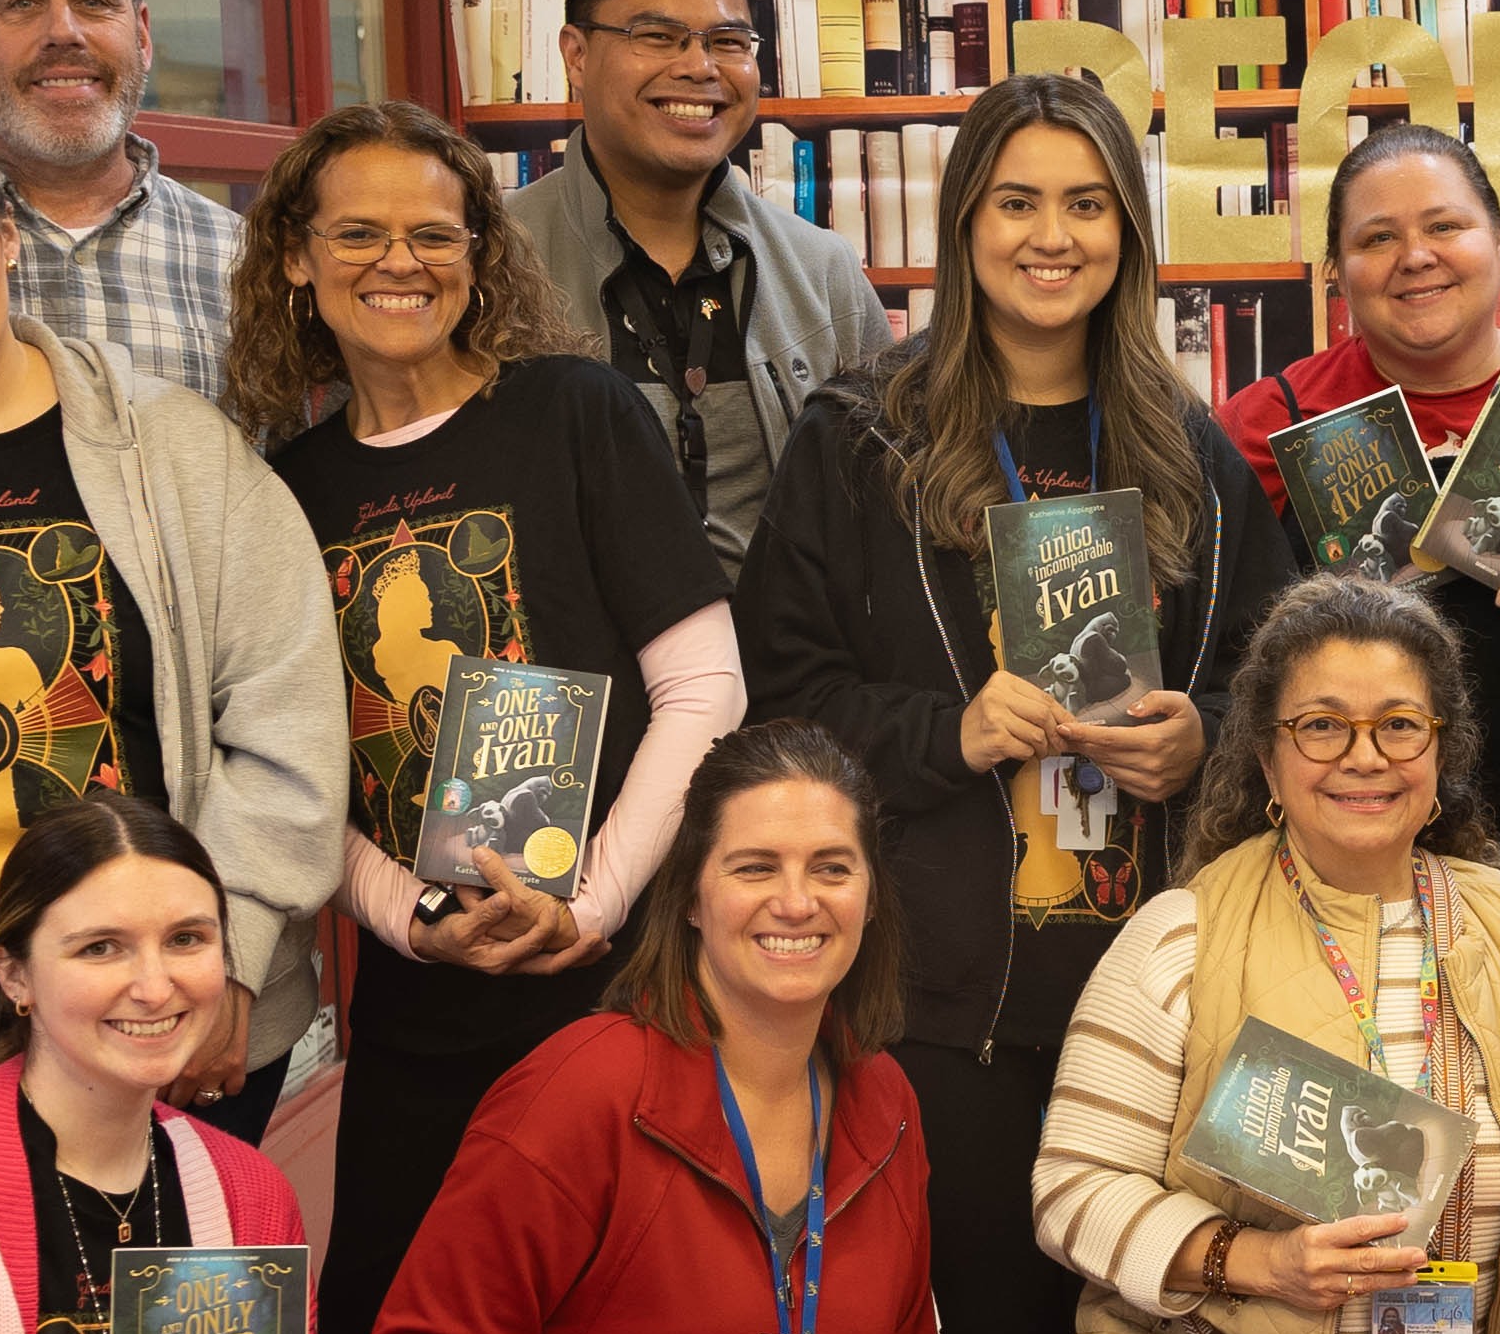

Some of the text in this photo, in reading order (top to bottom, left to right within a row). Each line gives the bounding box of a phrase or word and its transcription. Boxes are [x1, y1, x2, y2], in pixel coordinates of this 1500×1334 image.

[1322, 427, 1360, 467] ONE
[1337, 439, 1381, 485] ONLY
[404, 483, 457, 513] Upland
[1036, 468, 1089, 491] Upland
[1329, 462, 1397, 525] Ivan
[1035, 537, 1113, 582] incomparable
[1038, 524, 1092, 563] único
[1035, 567, 1121, 632] Iván
[494, 687, 542, 717] ONE
[498, 714, 560, 743] ONLY
[472, 734, 557, 780] Ivan
[1239, 1076, 1272, 1138] único
[1264, 1066, 1292, 1154] incomparable
[1277, 1079, 1334, 1178] Iván
[176, 1272, 229, 1314] ONE
